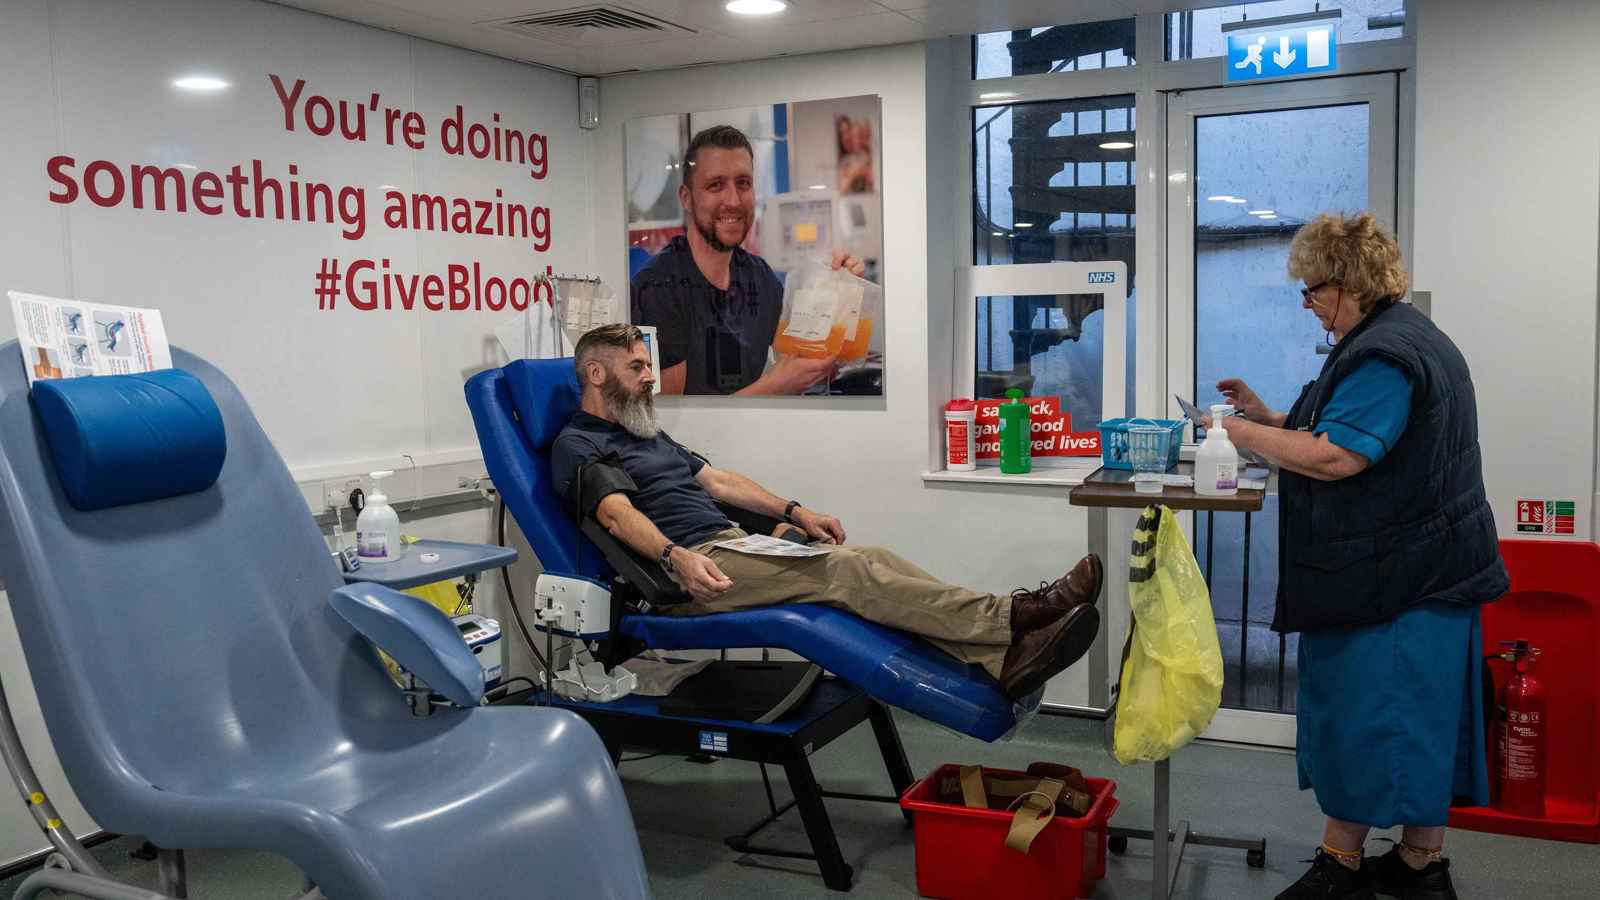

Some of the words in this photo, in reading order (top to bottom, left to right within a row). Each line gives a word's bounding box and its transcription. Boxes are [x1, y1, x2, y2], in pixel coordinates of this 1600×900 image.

[268, 74, 427, 150] You’re
[440, 103, 549, 180] doing
[46, 155, 367, 241] something
[383, 187, 553, 253] amazing
[1089, 272, 1114, 283] NHS
[982, 406, 1000, 417] sa
[1029, 400, 1053, 416] ck,
[975, 424, 1000, 439] gav
[1059, 435, 1098, 450] lives
